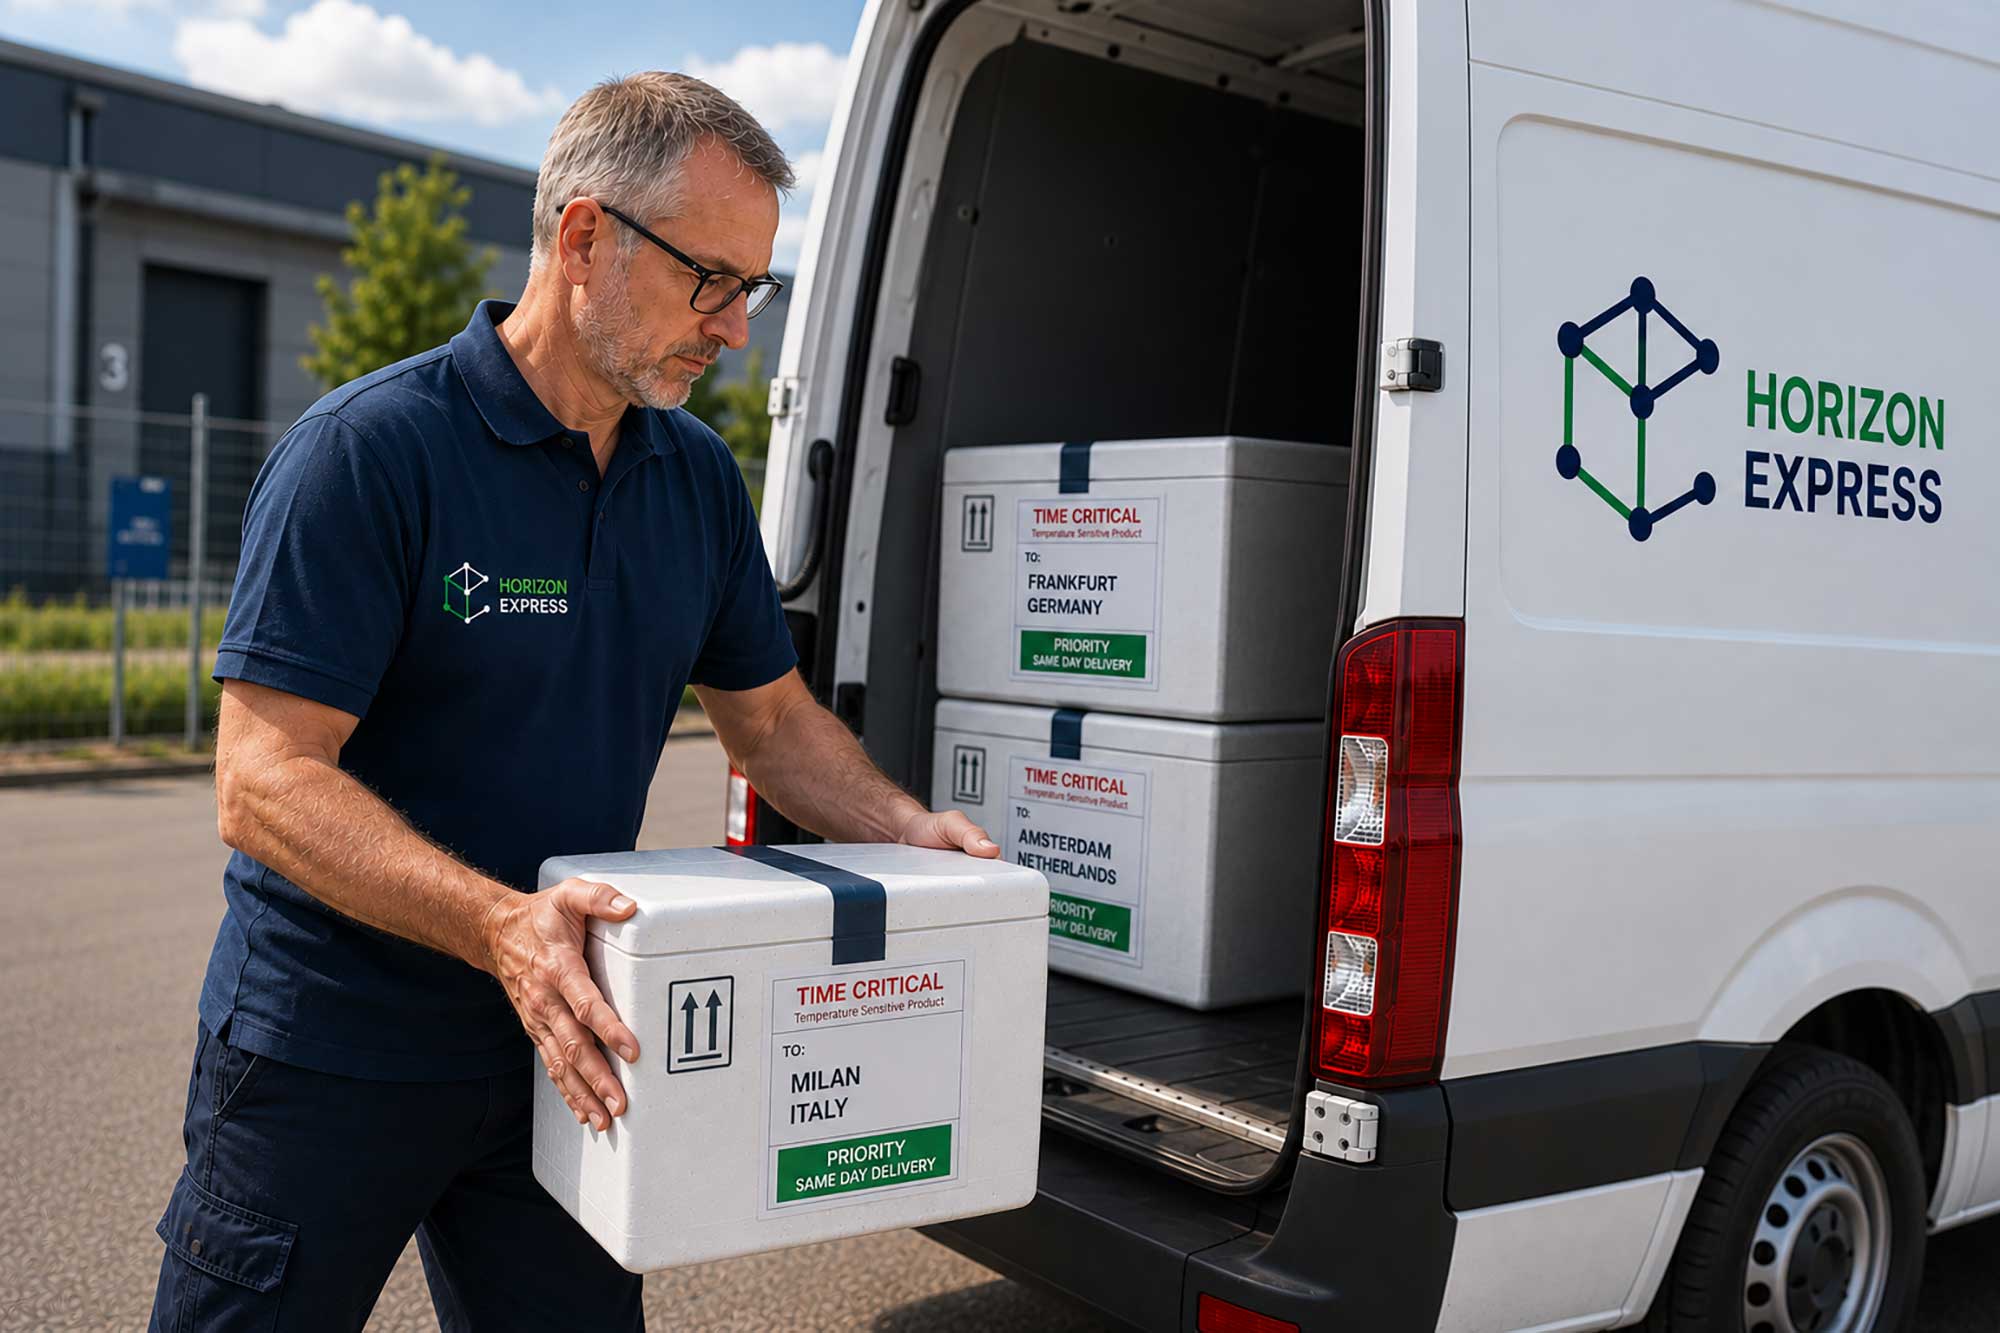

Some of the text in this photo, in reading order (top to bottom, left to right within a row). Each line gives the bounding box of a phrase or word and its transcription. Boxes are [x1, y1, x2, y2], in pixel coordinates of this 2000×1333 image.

[101, 343, 128, 391] 3
[1747, 369, 1944, 450] HORIZON
[1745, 450, 1942, 523] EXPRESS
[1033, 507, 1141, 524] TIME CRITICAL
[1032, 528, 1075, 539] Temperature
[1112, 528, 1142, 538] Product
[1025, 552, 1041, 562] TO:
[499, 578, 567, 594] HORIZON
[1028, 574, 1118, 591] FRANKFURT
[500, 598, 568, 614] EXPRESS
[1027, 597, 1103, 615] GERMANY
[1054, 638, 1110, 653] PRIORITY
[1033, 654, 1132, 671] SAME DAY DELIVERY
[1025, 767, 1128, 796] TIME CRITICAL
[1016, 807, 1031, 818] TO:
[1019, 829, 1111, 859] AMSTERDAM
[1017, 851, 1117, 885] NETHERLANDS
[1050, 898, 1096, 920] RIORITY
[1070, 922, 1117, 943] DELIVERY
[797, 972, 944, 1006] TIME CRITICAL
[795, 997, 945, 1024] Temperature Sensitive Product
[783, 1044, 805, 1057] TO:
[791, 1066, 861, 1094] MILAN
[790, 1097, 849, 1125] ITALY
[827, 1140, 906, 1167] PRIORITY
[796, 1157, 936, 1192] SAME DAY DELIVERY
